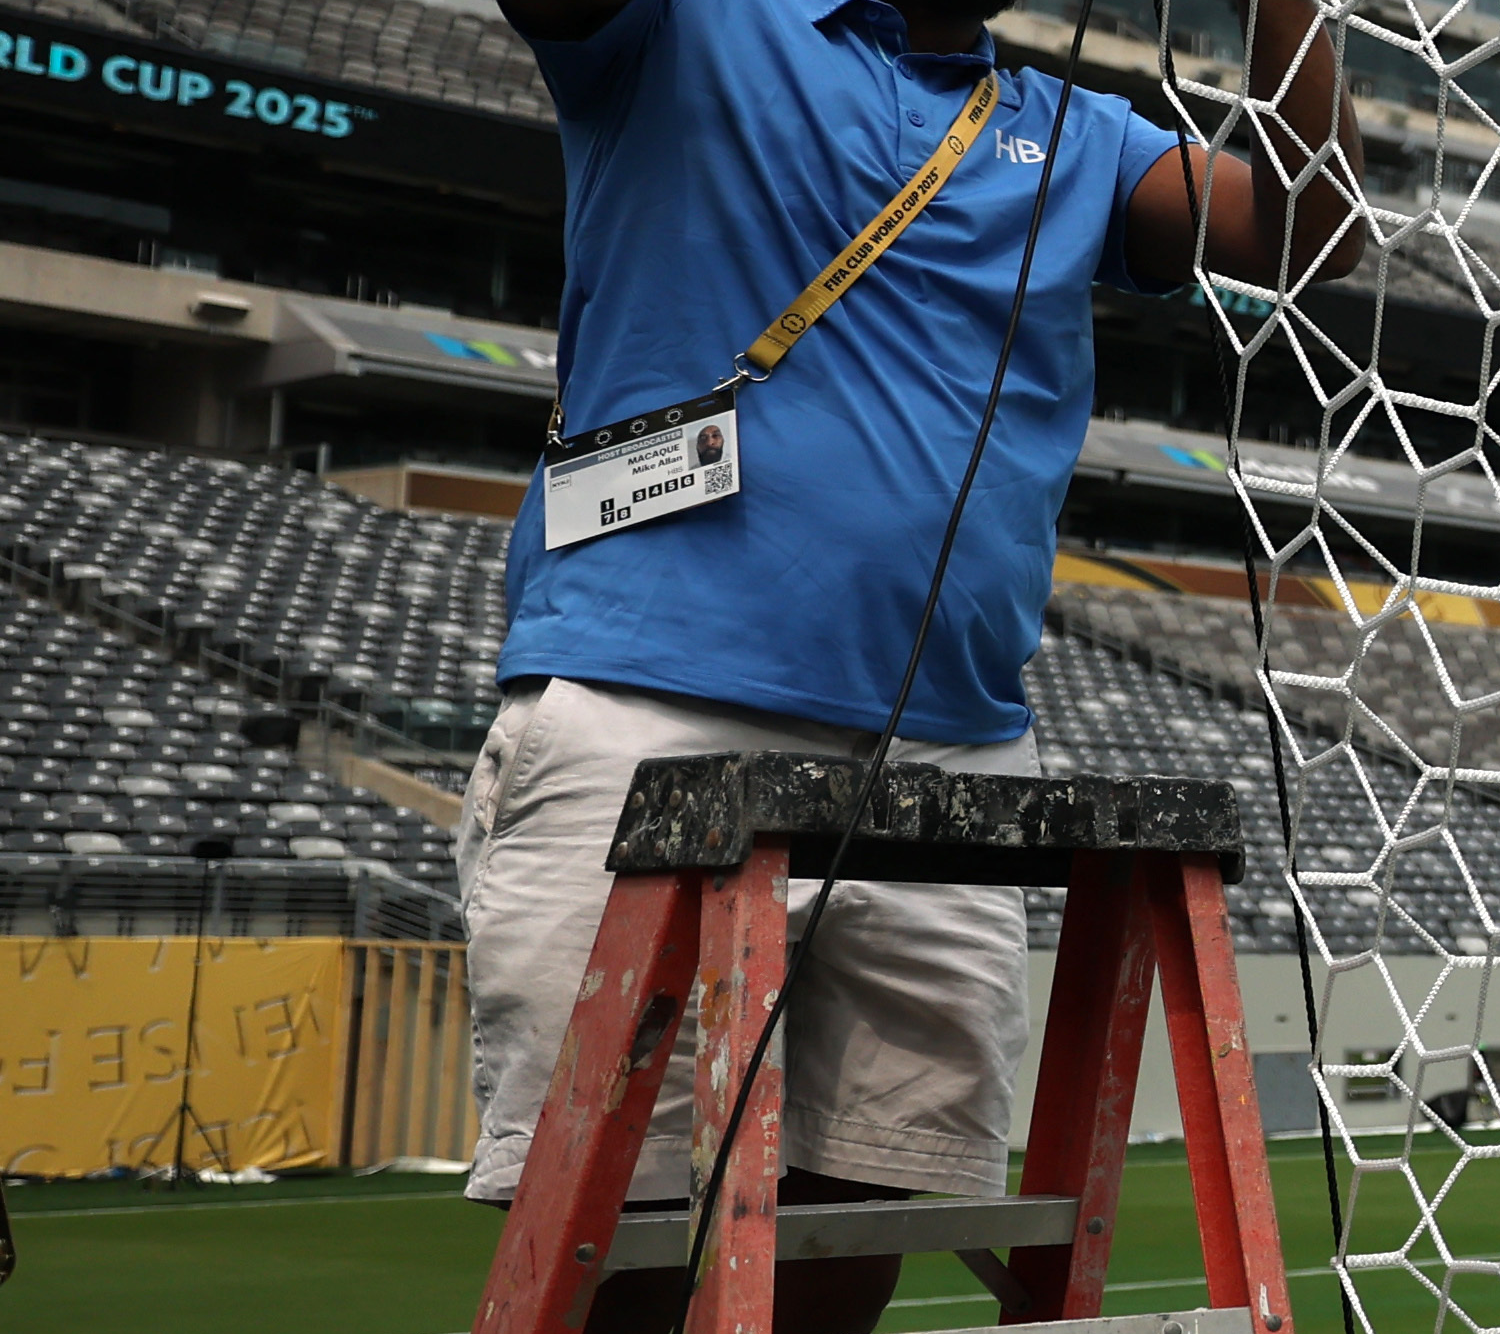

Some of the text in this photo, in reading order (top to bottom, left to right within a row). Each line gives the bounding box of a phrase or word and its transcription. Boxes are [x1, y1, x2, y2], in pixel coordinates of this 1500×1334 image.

[101, 54, 214, 107] CUP
[968, 104, 984, 125] FIFA
[823, 267, 851, 293] FIFA
[846, 242, 874, 270] CLUB
[869, 209, 905, 245] WORLD
[901, 190, 921, 213] CUP
[597, 448, 622, 463] HOST
[620, 429, 683, 457] BROADCASTER
[627, 443, 681, 466] MACAQUE
[631, 454, 684, 476] Mike Allan
